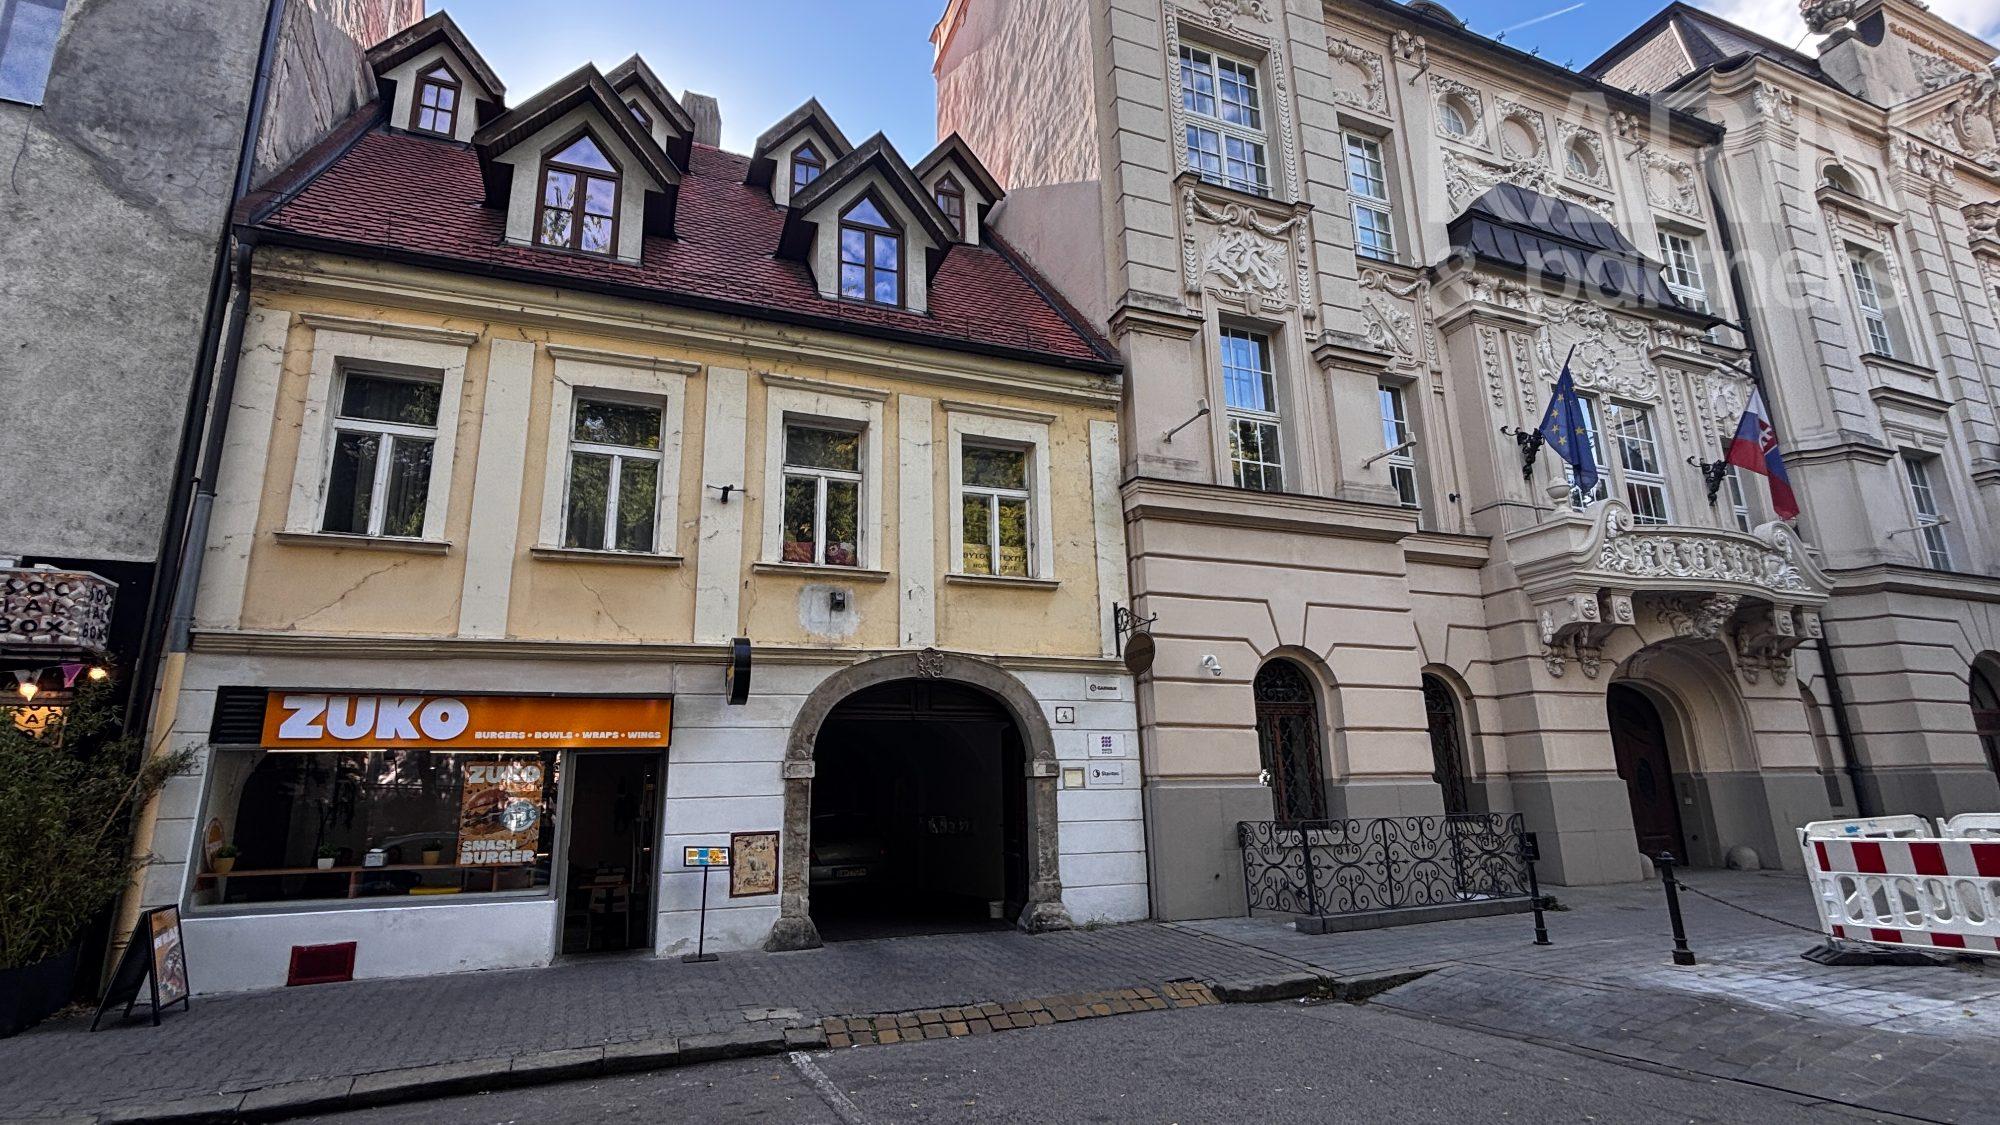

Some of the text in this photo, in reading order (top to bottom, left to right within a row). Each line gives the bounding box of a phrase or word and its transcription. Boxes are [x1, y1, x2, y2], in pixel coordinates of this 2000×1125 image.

[5, 578, 70, 597] SOC
[4, 599, 65, 614] IAL
[278, 695, 470, 740] ZUKO
[1062, 710, 1068, 720] 4
[474, 731, 662, 740] BURGERS BOWLS WRAPS WINGS
[469, 764, 541, 784] ZUKO
[461, 840, 517, 852] SMASH
[460, 849, 535, 865] BURGER
